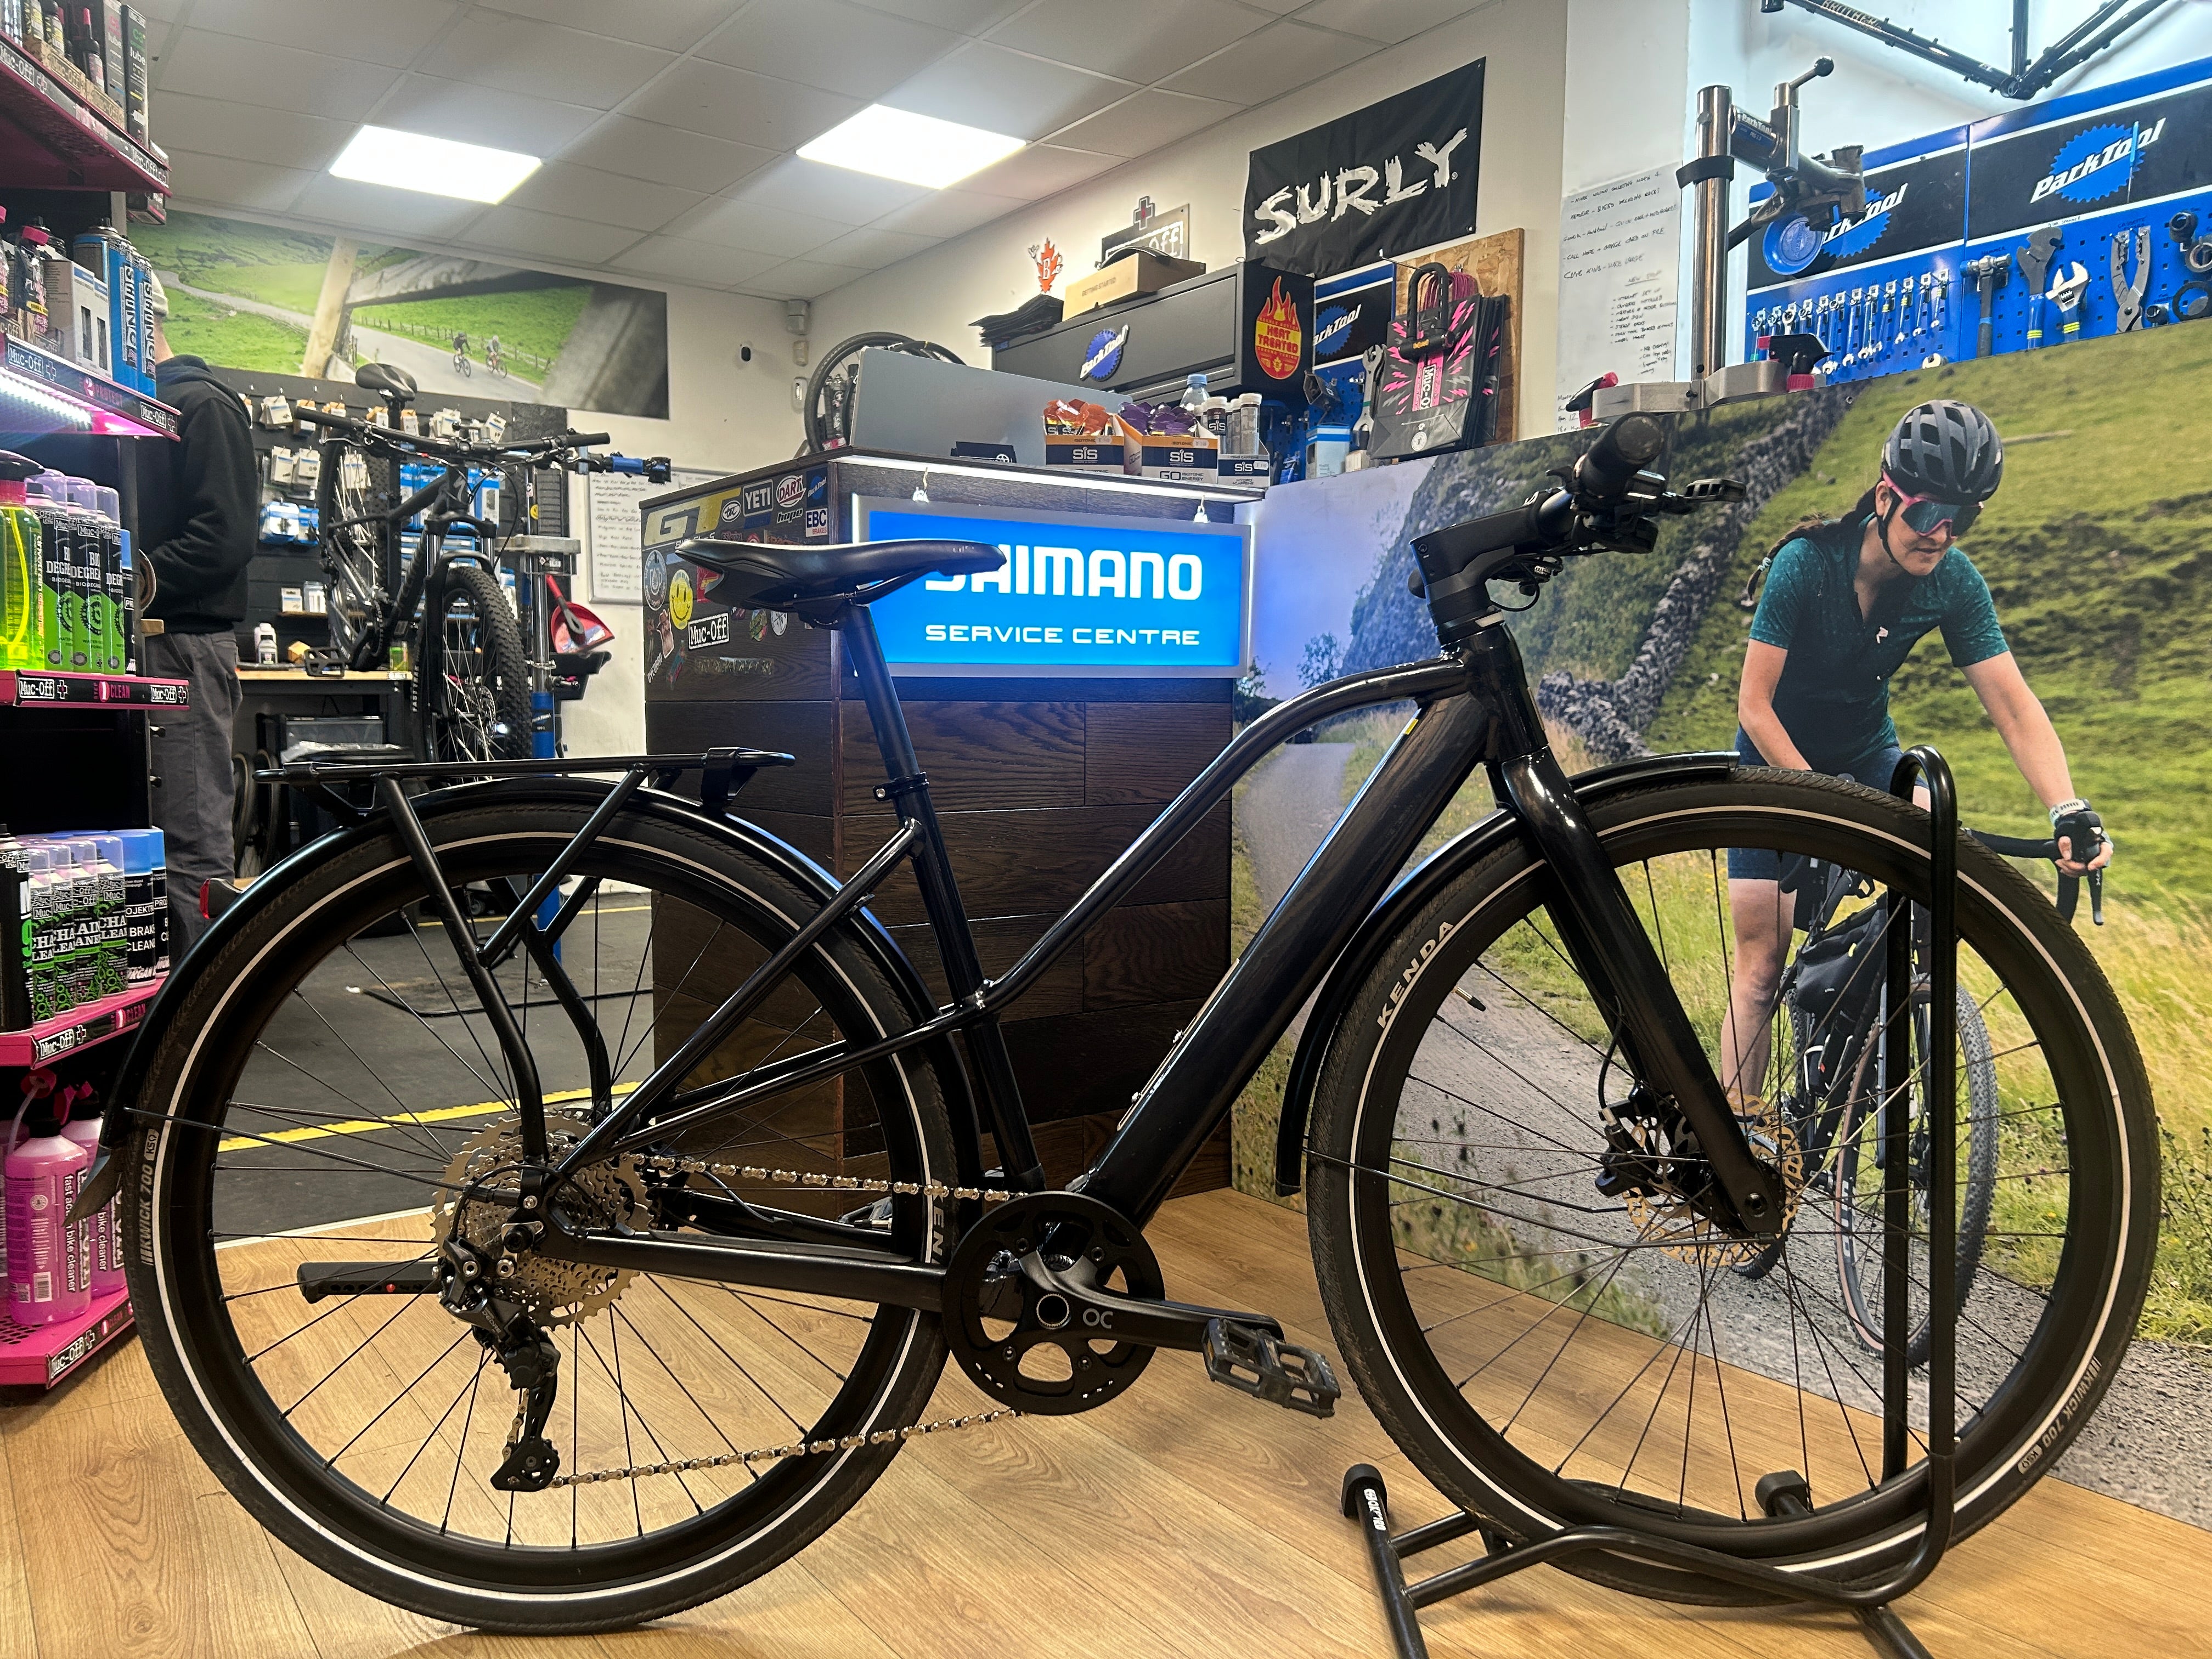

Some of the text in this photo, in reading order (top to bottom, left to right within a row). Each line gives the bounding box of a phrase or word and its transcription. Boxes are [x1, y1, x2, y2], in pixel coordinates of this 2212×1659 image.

[130, 46, 146, 65] lube
[2030, 117, 2166, 204] ParkTool
[1254, 127, 1468, 245] SURLY
[1822, 183, 1908, 244] rkTool
[1042, 258, 1051, 280] B
[1098, 277, 1116, 289] STARTED
[1267, 325, 1291, 341] HEAT
[1313, 303, 1362, 345] arkTool
[1257, 334, 1299, 354] TREATED
[9, 347, 42, 374] Muc-Off
[1421, 365, 1435, 410] Muc-O
[142, 404, 166, 427] Muc-Off
[1159, 471, 1181, 481] GO
[745, 487, 771, 510] YETI
[644, 487, 741, 547] GT
[777, 509, 803, 523] hope
[806, 510, 827, 528] EBC
[812, 527, 827, 535] BRAKES
[71, 566, 100, 581] DEGREA
[690, 618, 727, 646] Muc-Off
[925, 624, 1200, 646] SERVICE CENTRE
[20, 680, 53, 697] Muc-Off
[110, 684, 131, 699] CLEAN
[152, 686, 176, 701] Muc-Off
[55, 902, 73, 912] Muc-
[73, 896, 96, 906] c-Off
[126, 906, 154, 916] OJEKT
[35, 908, 52, 917] Muc-
[99, 915, 127, 928] CHA
[74, 921, 100, 935] AIN
[100, 927, 127, 939] LEA
[32, 934, 54, 949] CHA
[1376, 921, 1454, 1029] KENDA
[41, 1031, 73, 1057] Muc-Off
[139, 1163, 154, 1249] KWICK 700
[931, 1178, 944, 1264] KEN
[66, 1231, 76, 1253] bike
[98, 1211, 108, 1271] bike cleaner
[66, 1254, 76, 1293] cleaner
[2041, 1372, 2094, 1448] KWICK 700
